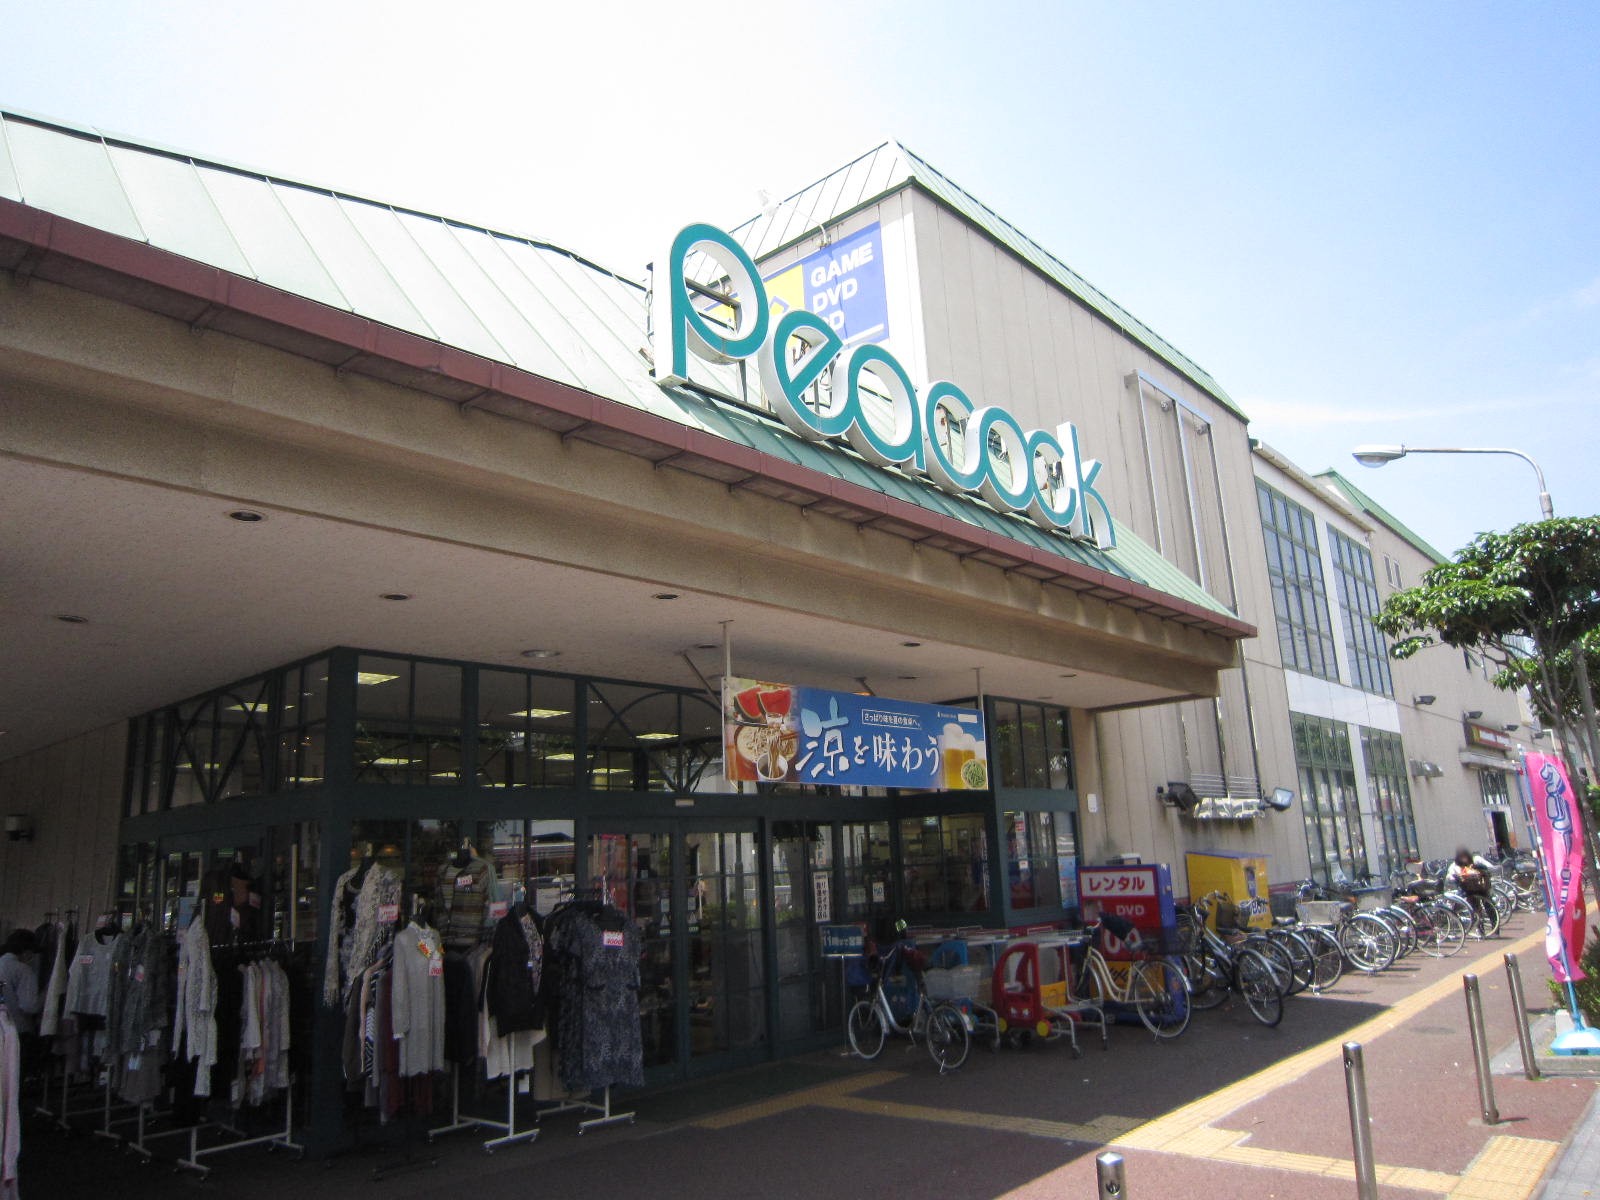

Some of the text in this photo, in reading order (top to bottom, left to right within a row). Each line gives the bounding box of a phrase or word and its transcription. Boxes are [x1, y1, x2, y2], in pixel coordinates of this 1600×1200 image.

[811, 241, 874, 287] GAME
[812, 278, 858, 313] DVD
[657, 223, 1116, 550] Peacock
[795, 696, 941, 778] 涼を味わう
[1089, 876, 1145, 892] レンタル
[1116, 904, 1145, 916] DVD
